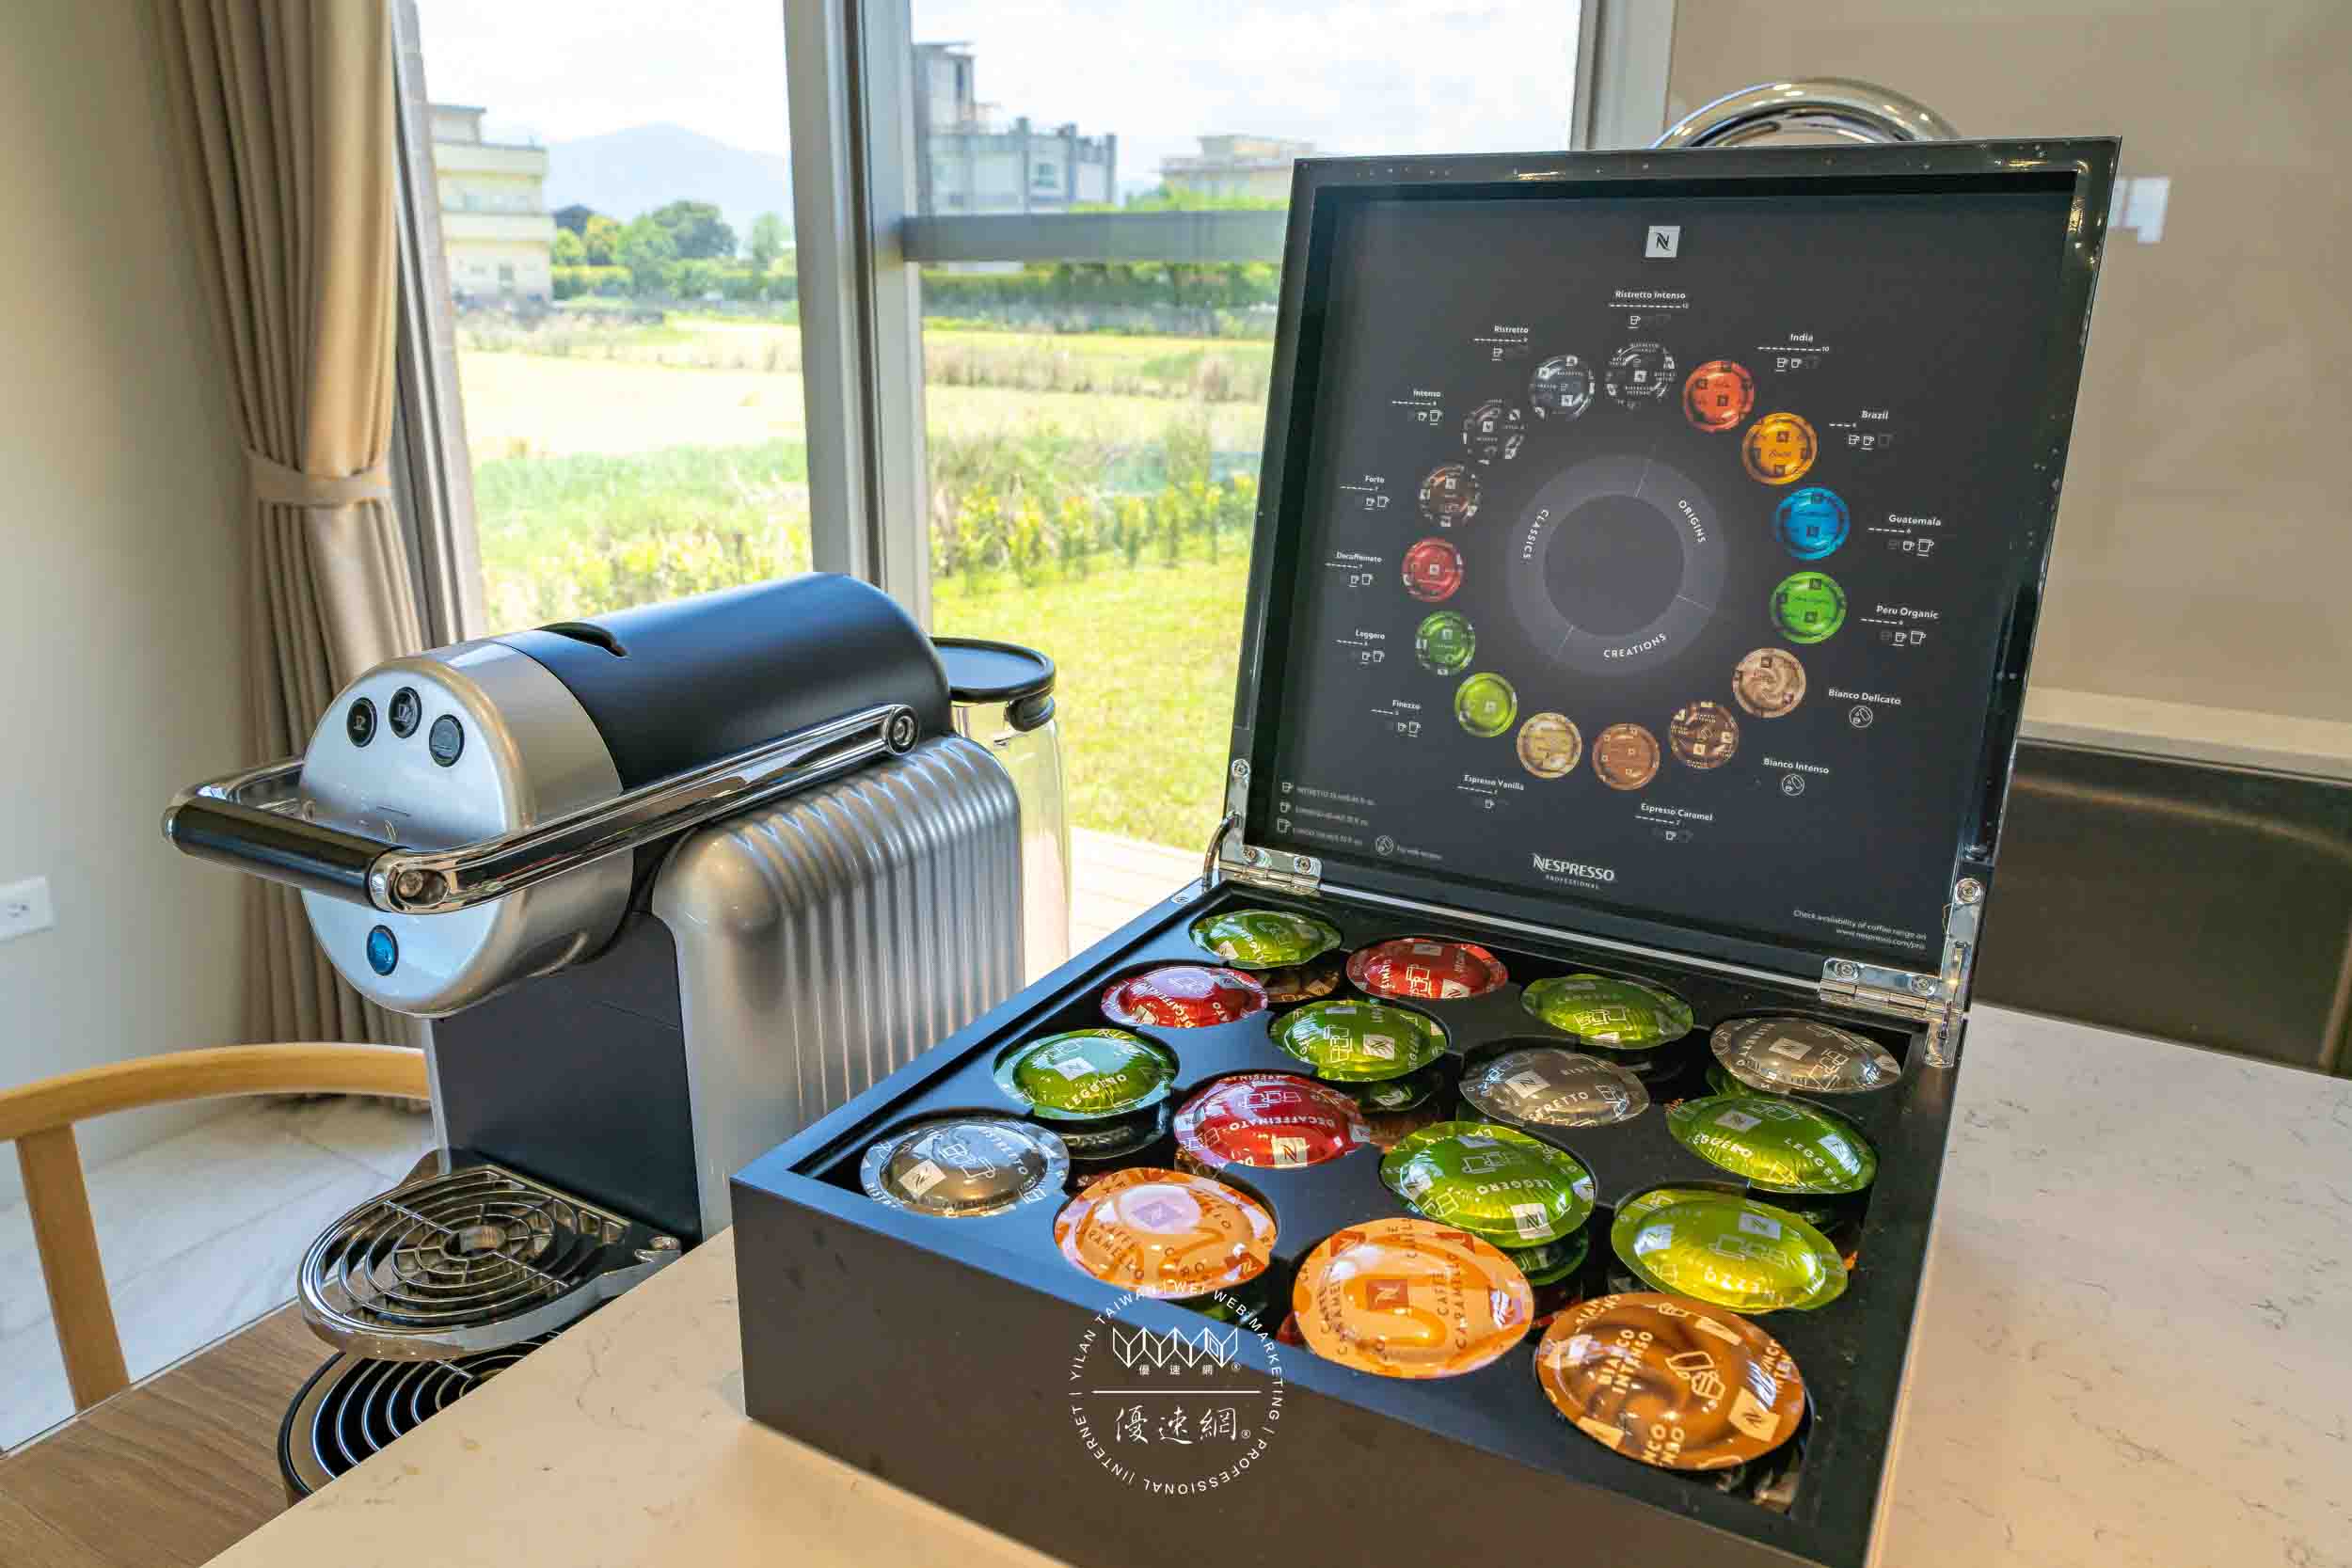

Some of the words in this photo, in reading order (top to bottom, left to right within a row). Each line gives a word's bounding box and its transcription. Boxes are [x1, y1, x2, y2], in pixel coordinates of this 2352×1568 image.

[1615, 290, 1652, 299] Ristretto
[1654, 290, 1686, 299] Intenso
[1494, 325, 1529, 334] Ristretto
[1790, 333, 1814, 342] India
[1861, 410, 1889, 420] Brazil
[1678, 499, 1707, 544] ORIGINS
[1888, 515, 1942, 527] Guatemala
[1523, 508, 1549, 560] CLASSICS
[1876, 605, 1899, 616] Peru
[1899, 608, 1940, 620] Organic
[1355, 629, 1386, 641] Leggero
[1603, 632, 1667, 659] CREATIONS
[1828, 689, 1860, 700] Bianco
[1861, 692, 1901, 705] Delicato
[1763, 758, 1794, 769] Bianco
[1795, 762, 1830, 774] Intenso
[1464, 774, 1497, 786] Espresso
[1497, 779, 1525, 791] Vanilla
[1641, 802, 1677, 816] Espresso
[1677, 809, 1713, 821] Caramel
[1533, 853, 1615, 882] NESPRESSO
[1793, 909, 1817, 920] Check
[1817, 915, 1856, 929] availability
[1857, 921, 1867, 929] of
[1229, 1115, 1335, 1132] DECAFFEINATO
[1783, 1136, 1853, 1190] LEGGERO
[1476, 1178, 1554, 1196] LEGGERO
[1597, 1328, 1635, 1386] BIANCO
[1612, 1331, 1654, 1395] INTENSO
